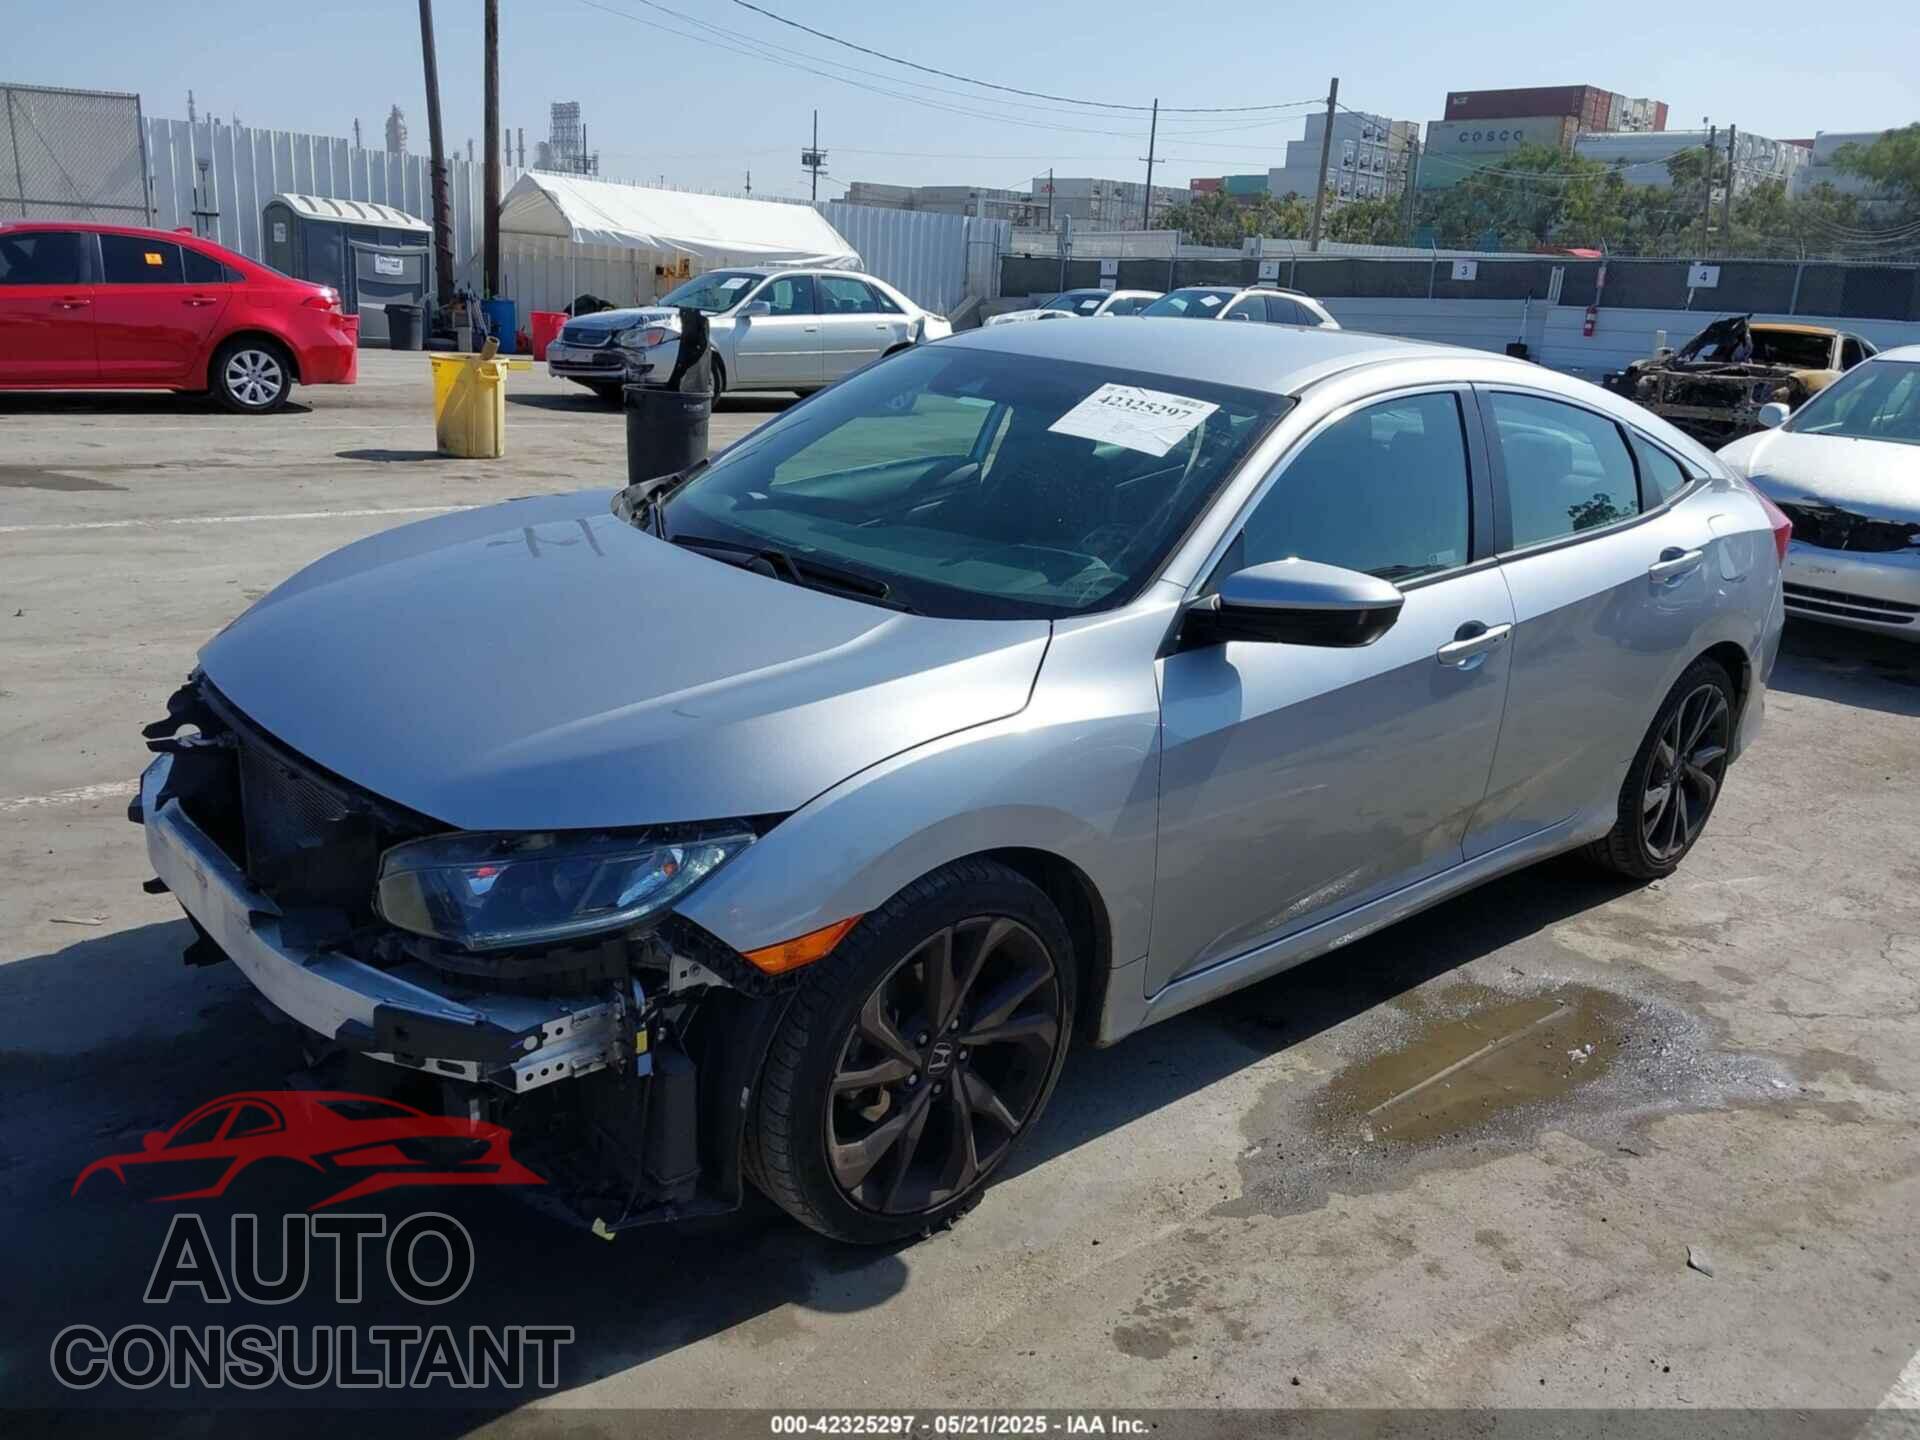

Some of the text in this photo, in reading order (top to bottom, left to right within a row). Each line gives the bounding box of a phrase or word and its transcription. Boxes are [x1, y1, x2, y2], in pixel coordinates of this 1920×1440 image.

[1458, 129, 1524, 143] COSCO
[1461, 265, 1468, 276] 3
[1699, 271, 1707, 282] 4
[1098, 394, 1192, 420] 42325297
